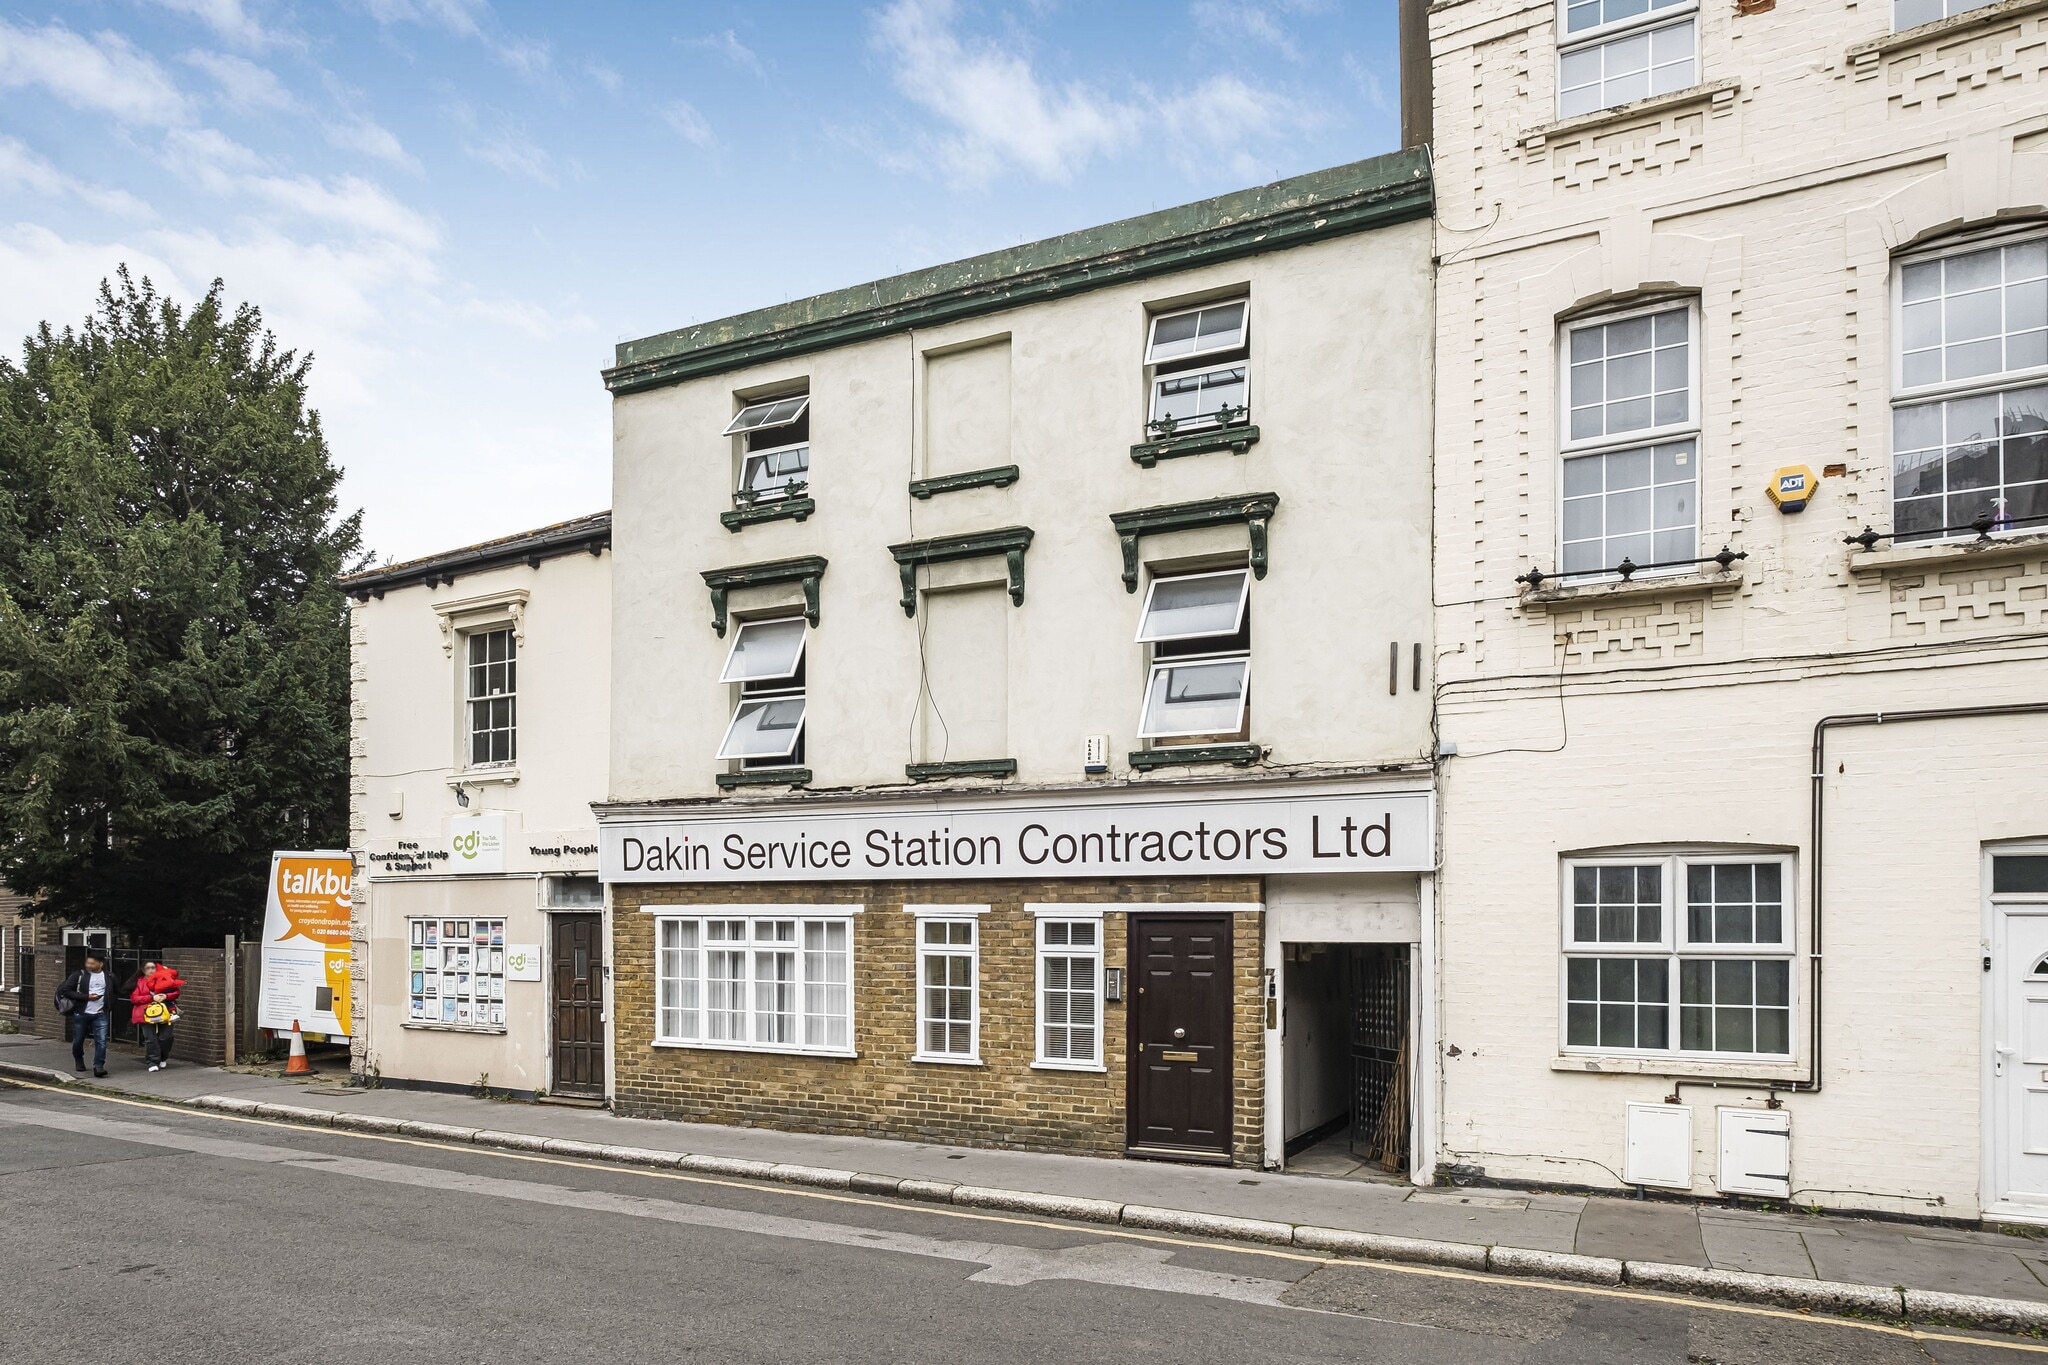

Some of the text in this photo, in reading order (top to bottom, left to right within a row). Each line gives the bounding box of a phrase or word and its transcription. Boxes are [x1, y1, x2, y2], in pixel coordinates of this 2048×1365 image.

[1781, 477, 1804, 489] ADT
[398, 841, 419, 850] Free
[453, 830, 480, 852] cdi
[623, 813, 1390, 871] Dakin Service Station Contractors Ltd
[427, 850, 449, 860] Help
[529, 844, 599, 857] Young People
[385, 862, 392, 871] &
[329, 958, 344, 969] cdi
[508, 953, 526, 966] cdi
